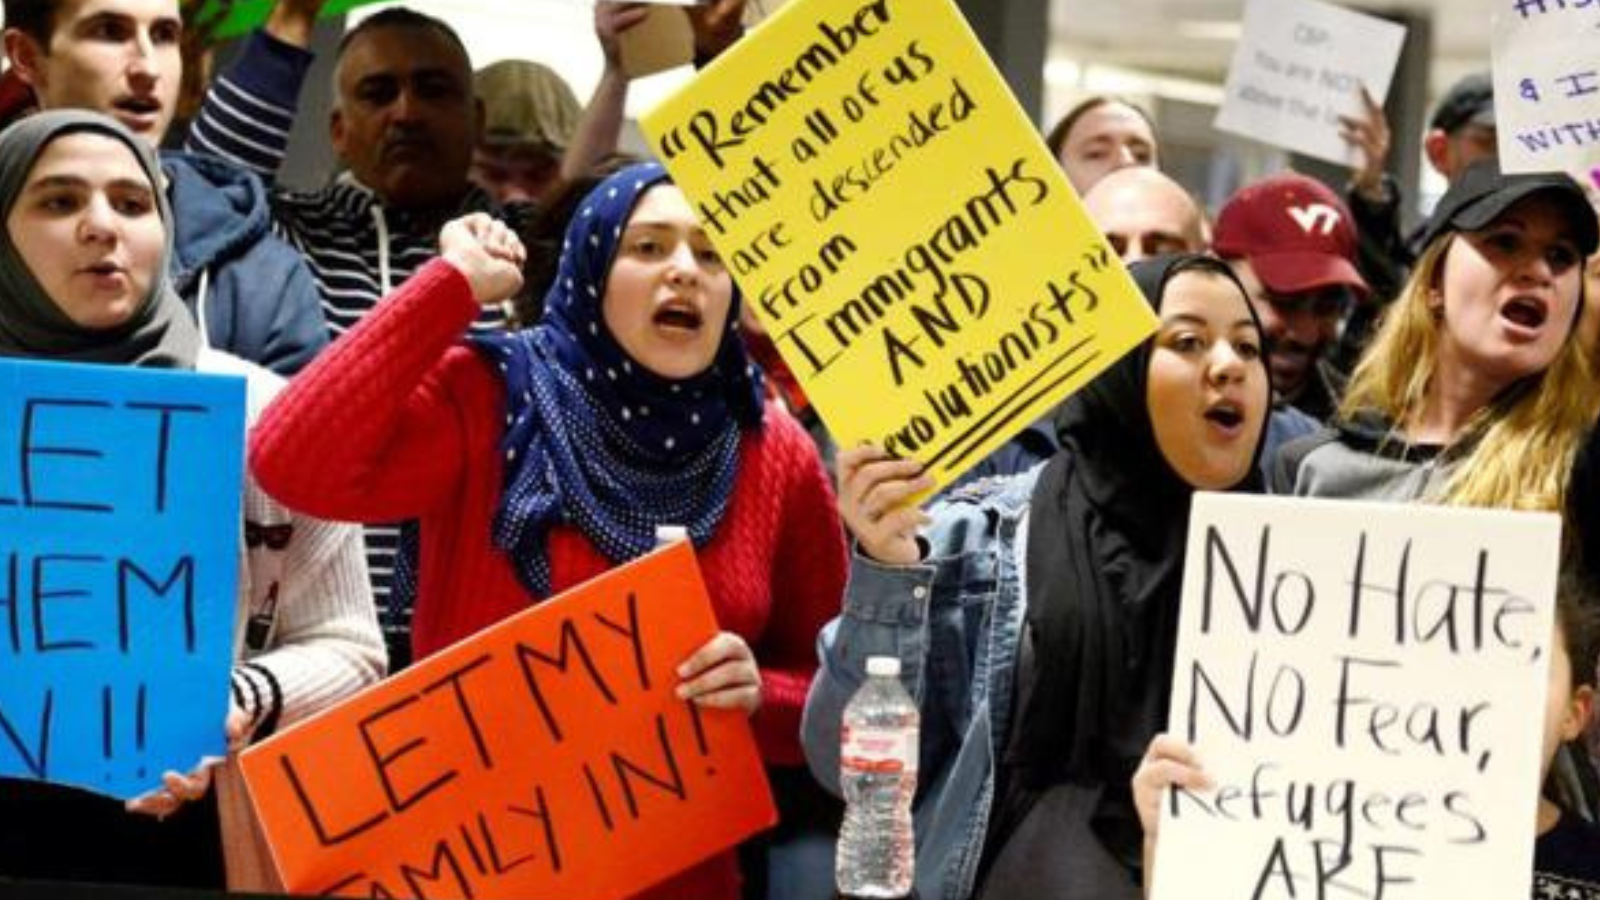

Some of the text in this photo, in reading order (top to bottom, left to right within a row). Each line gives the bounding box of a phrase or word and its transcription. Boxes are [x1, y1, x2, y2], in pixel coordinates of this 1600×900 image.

[697, 40, 935, 235] that all of us
[731, 78, 977, 276] are descended
[774, 158, 1049, 379] Immigrants
[881, 273, 991, 387] AND
[0, 398, 209, 512] ET
[1200, 524, 1542, 664] No Hate,
[281, 592, 653, 847] LET MY
[1333, 655, 1492, 772] Fear,
